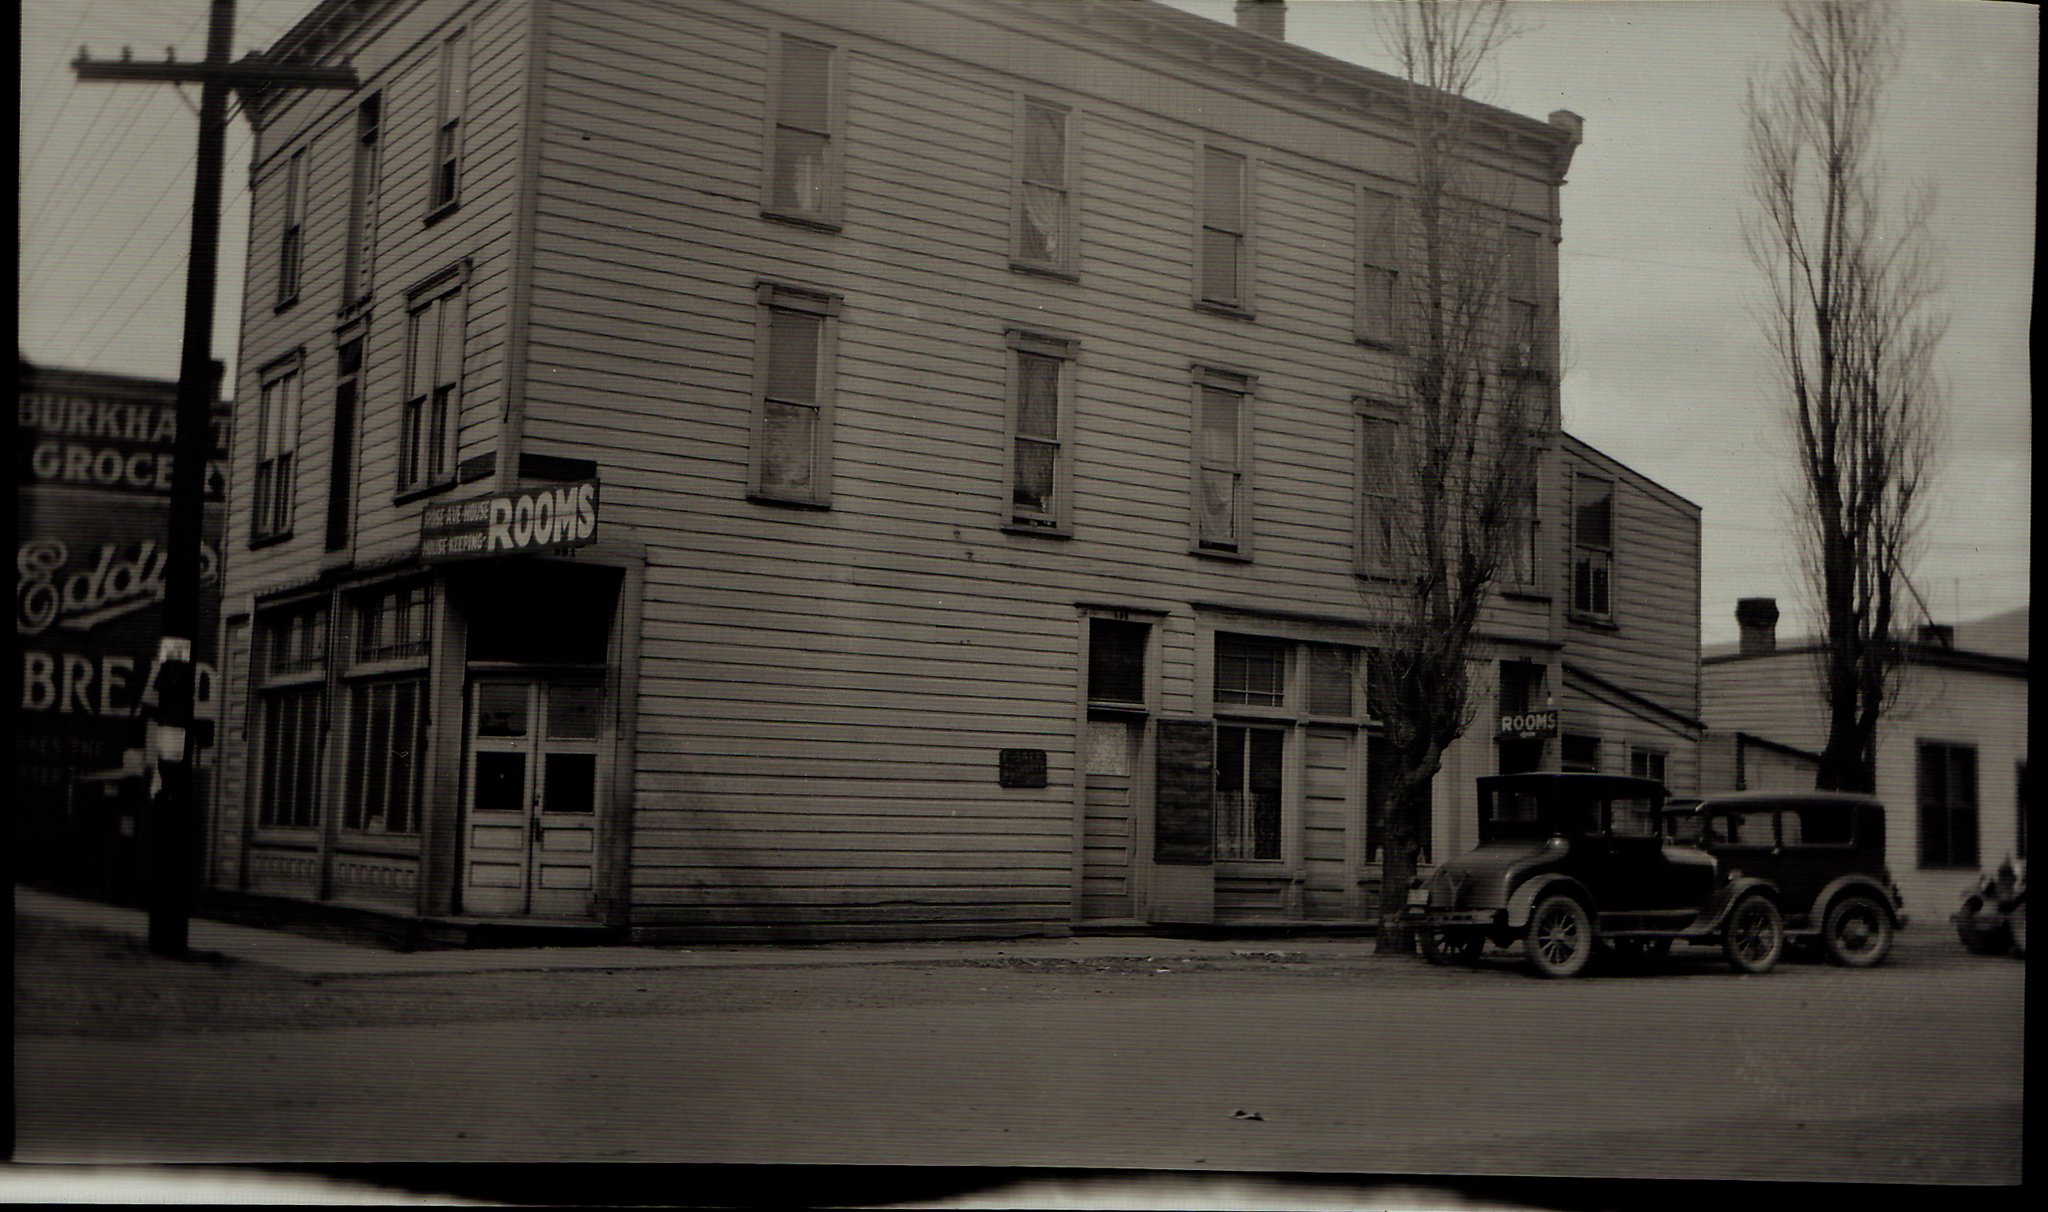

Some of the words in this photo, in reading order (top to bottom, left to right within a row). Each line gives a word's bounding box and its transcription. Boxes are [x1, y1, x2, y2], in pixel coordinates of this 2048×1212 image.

[18, 394, 231, 448] BURKHAT
[33, 441, 229, 494] GROCEY
[487, 484, 595, 551] ROOMS
[1502, 713, 1556, 732] ROOMS
